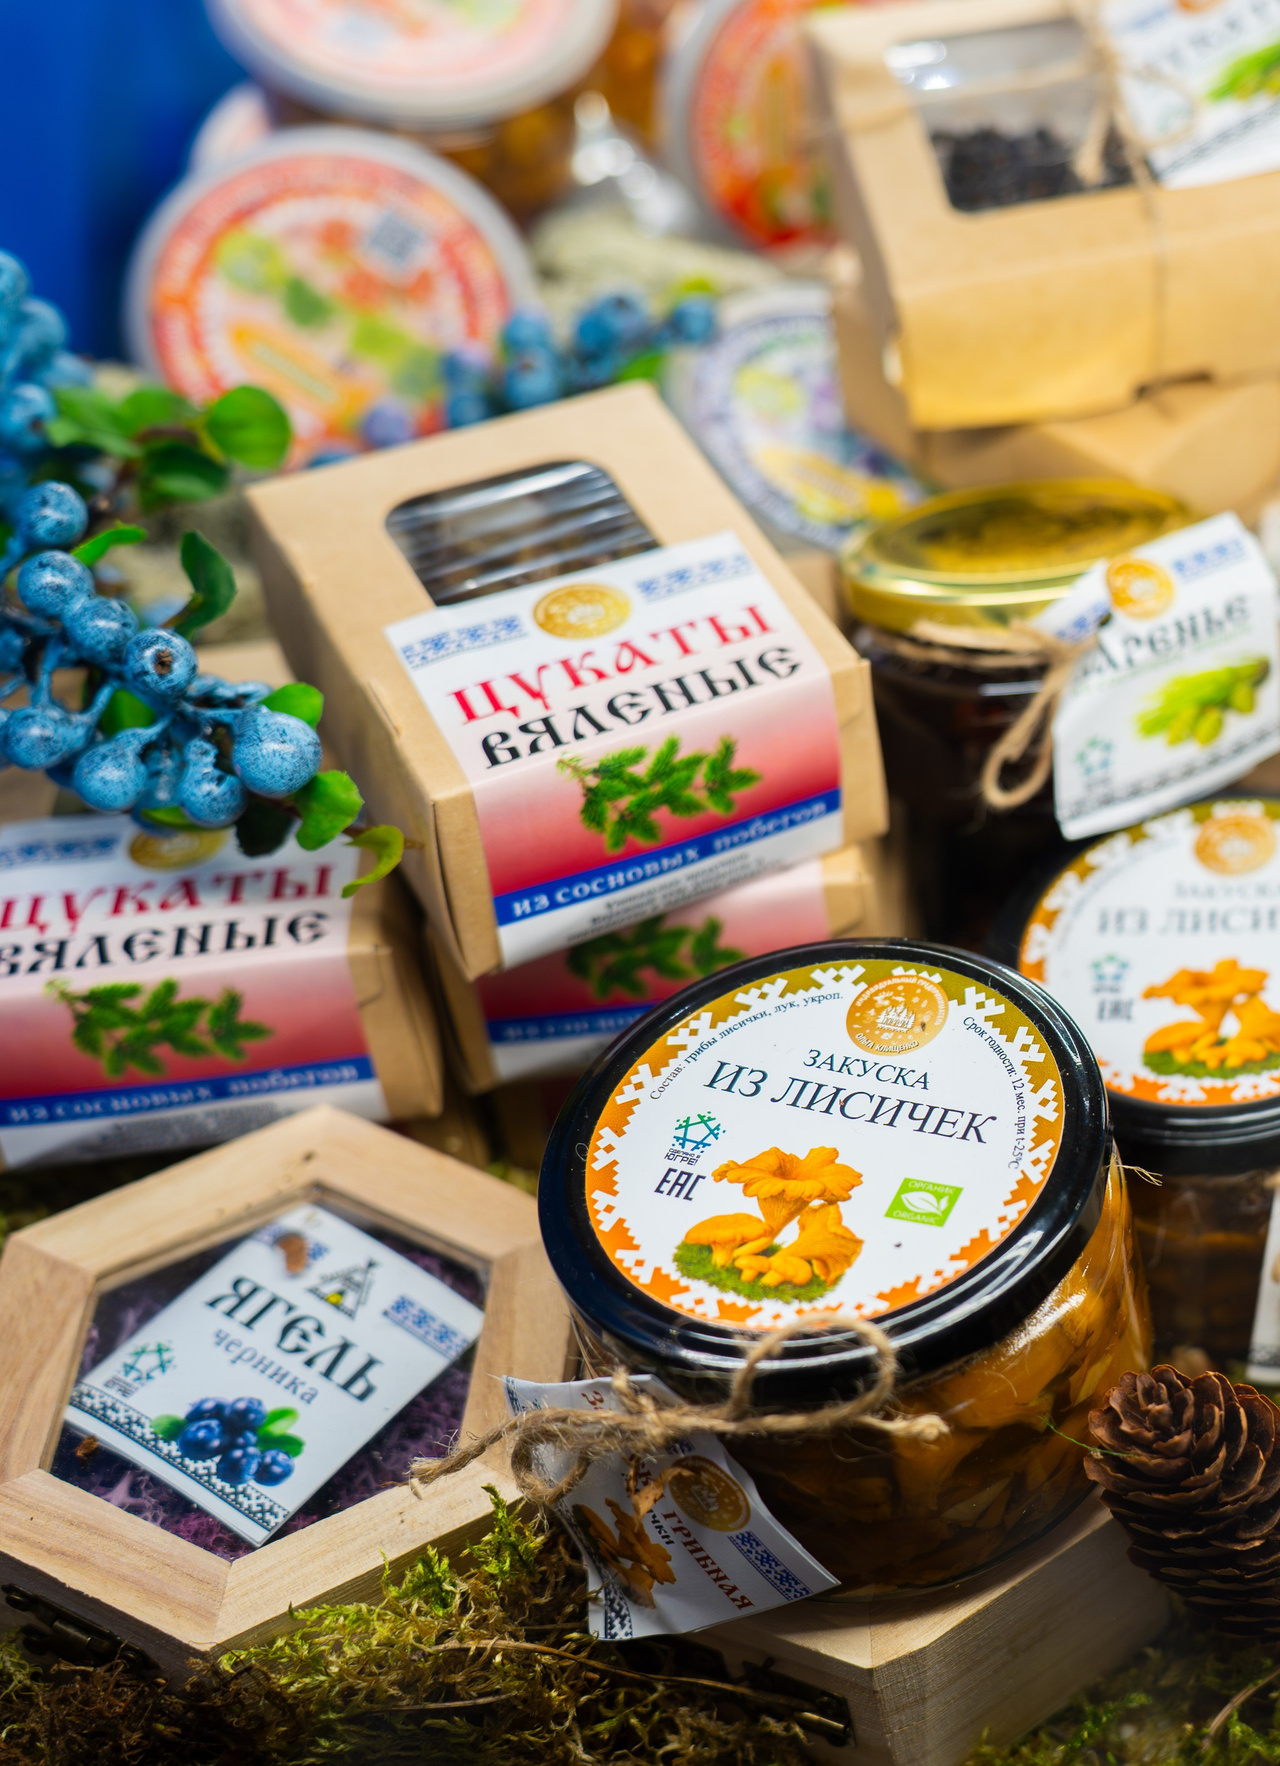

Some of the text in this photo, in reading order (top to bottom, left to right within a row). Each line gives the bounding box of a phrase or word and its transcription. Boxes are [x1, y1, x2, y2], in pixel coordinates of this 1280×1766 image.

[447, 604, 778, 725] ЦУКАТЫ
[1083, 595, 1251, 678] АРЕНЬЕ
[480, 645, 803, 770] ВЯЛЕНЫЕ
[0, 862, 338, 937] ЦУКАТЫ
[650, 992, 844, 1100] Состав: грибы лисички, лук, укроп.
[855, 1033, 920, 1053] ОЛЬГА КЛИЩЕНКО
[963, 1016, 988, 1039] Срок
[985, 1035, 1017, 1078] годности:
[803, 1049, 930, 1090] ЗАКУСКА
[1011, 1078, 1025, 1091] 12
[704, 1060, 998, 1144] ИЗ ЛИСИЧЕК
[1014, 1116, 1026, 1135] при
[1015, 1093, 1026, 1114] мес.
[893, 1210, 939, 1224] ORGANIC
[908, 1181, 956, 1195] ОРГАНИК
[205, 1274, 384, 1402] ЯГЕЛЬ
[212, 1327, 320, 1406] черника
[662, 1510, 756, 1610] ГРИБНАЯ
